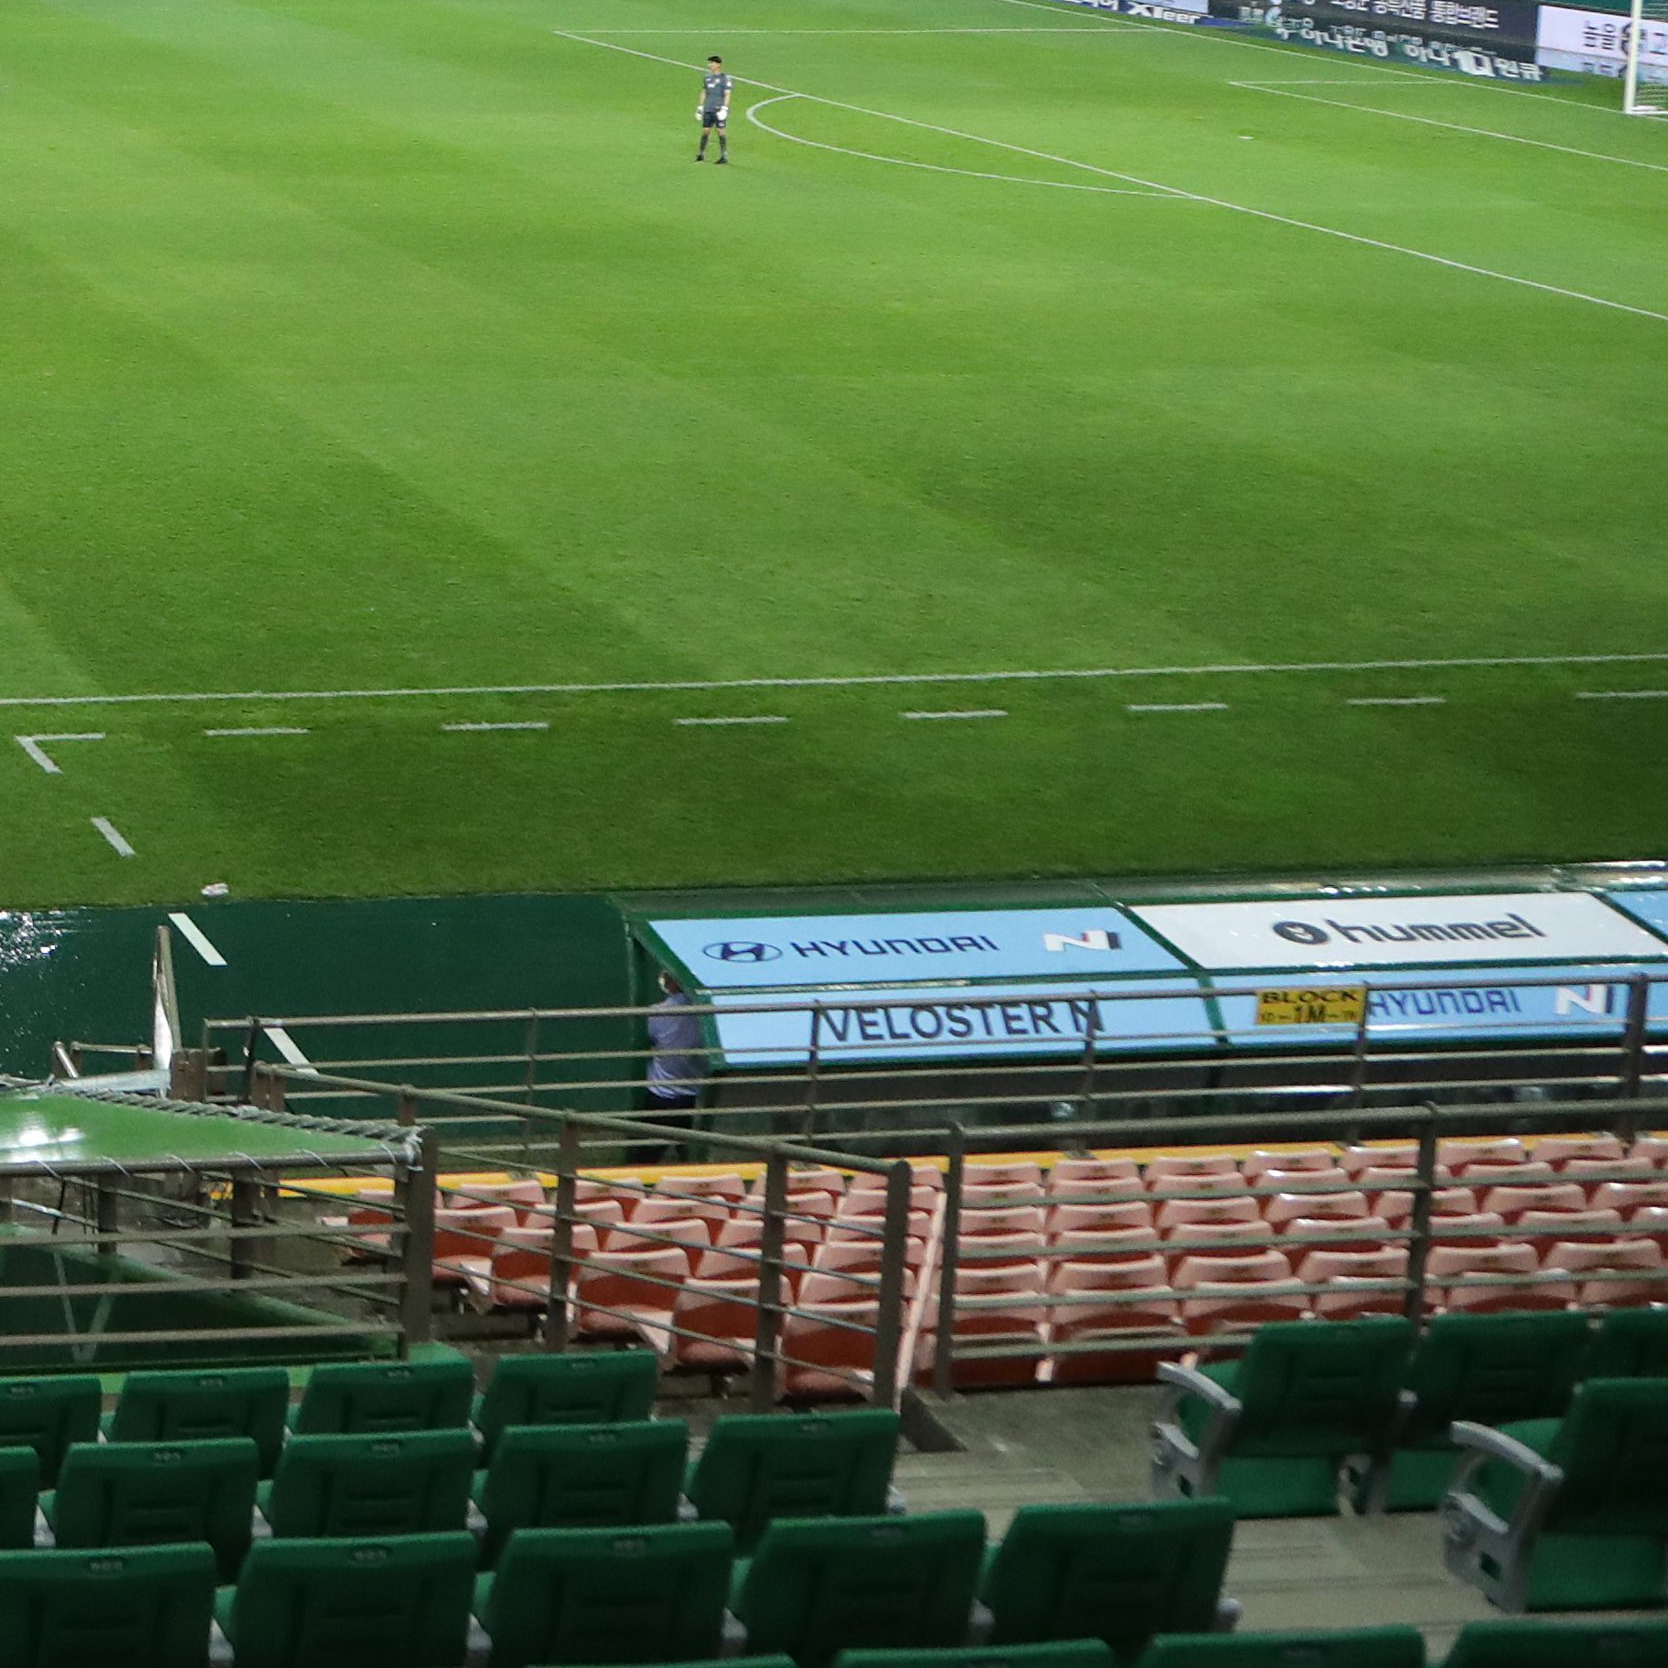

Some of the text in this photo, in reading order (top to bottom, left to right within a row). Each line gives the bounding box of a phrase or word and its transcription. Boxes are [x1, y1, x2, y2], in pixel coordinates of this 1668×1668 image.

[1324, 913, 1546, 943] hummel
[791, 936, 1000, 958] HYUNDAI
[1263, 990, 1359, 1003] BLOCK
[1368, 989, 1521, 1017] HYUNDAI
[816, 1003, 1062, 1042] VELOSTER
